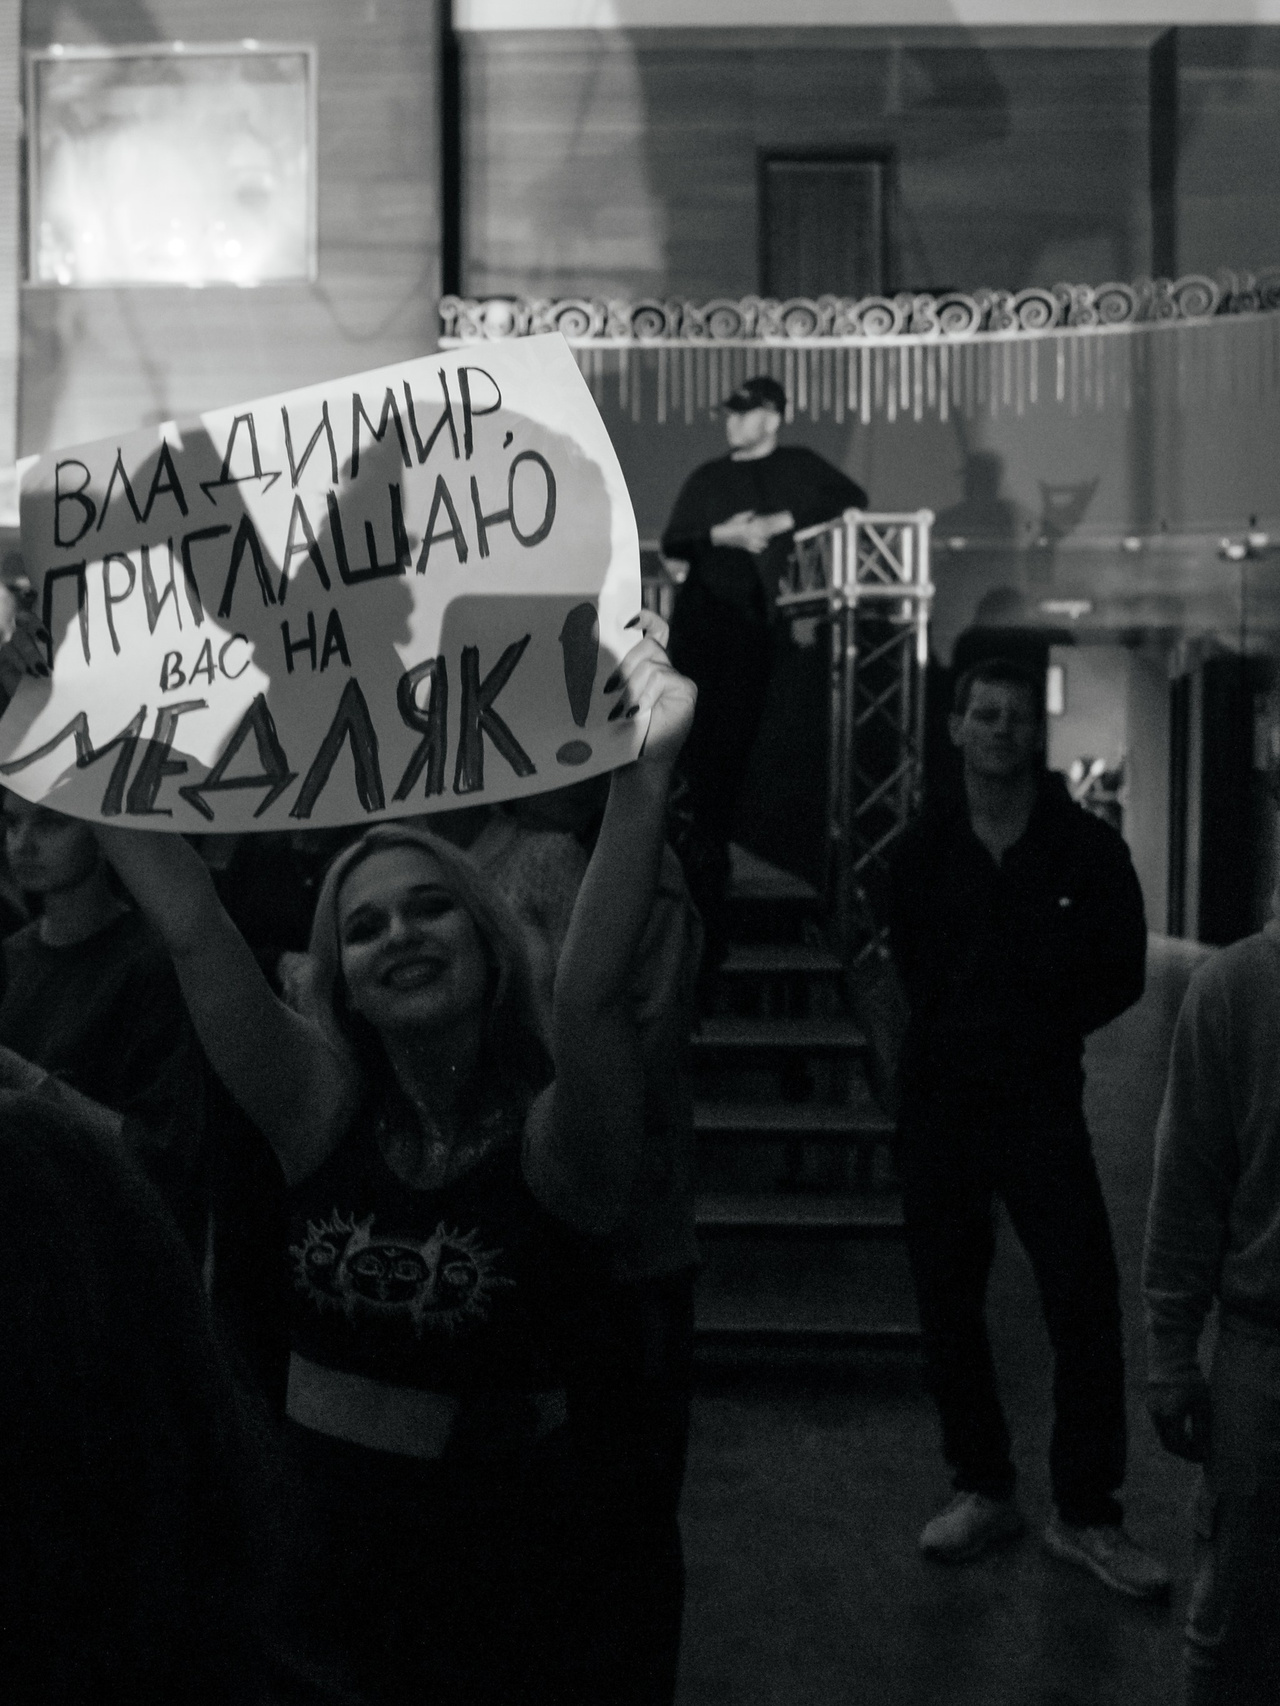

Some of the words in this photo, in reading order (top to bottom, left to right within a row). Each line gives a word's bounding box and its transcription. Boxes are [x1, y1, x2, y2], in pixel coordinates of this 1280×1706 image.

[53, 367, 514, 548] ВЛАДИМИР,
[42, 450, 557, 670] ПРИГЛАШАЮ
[159, 633, 250, 692] ВАС
[281, 609, 352, 674] НА
